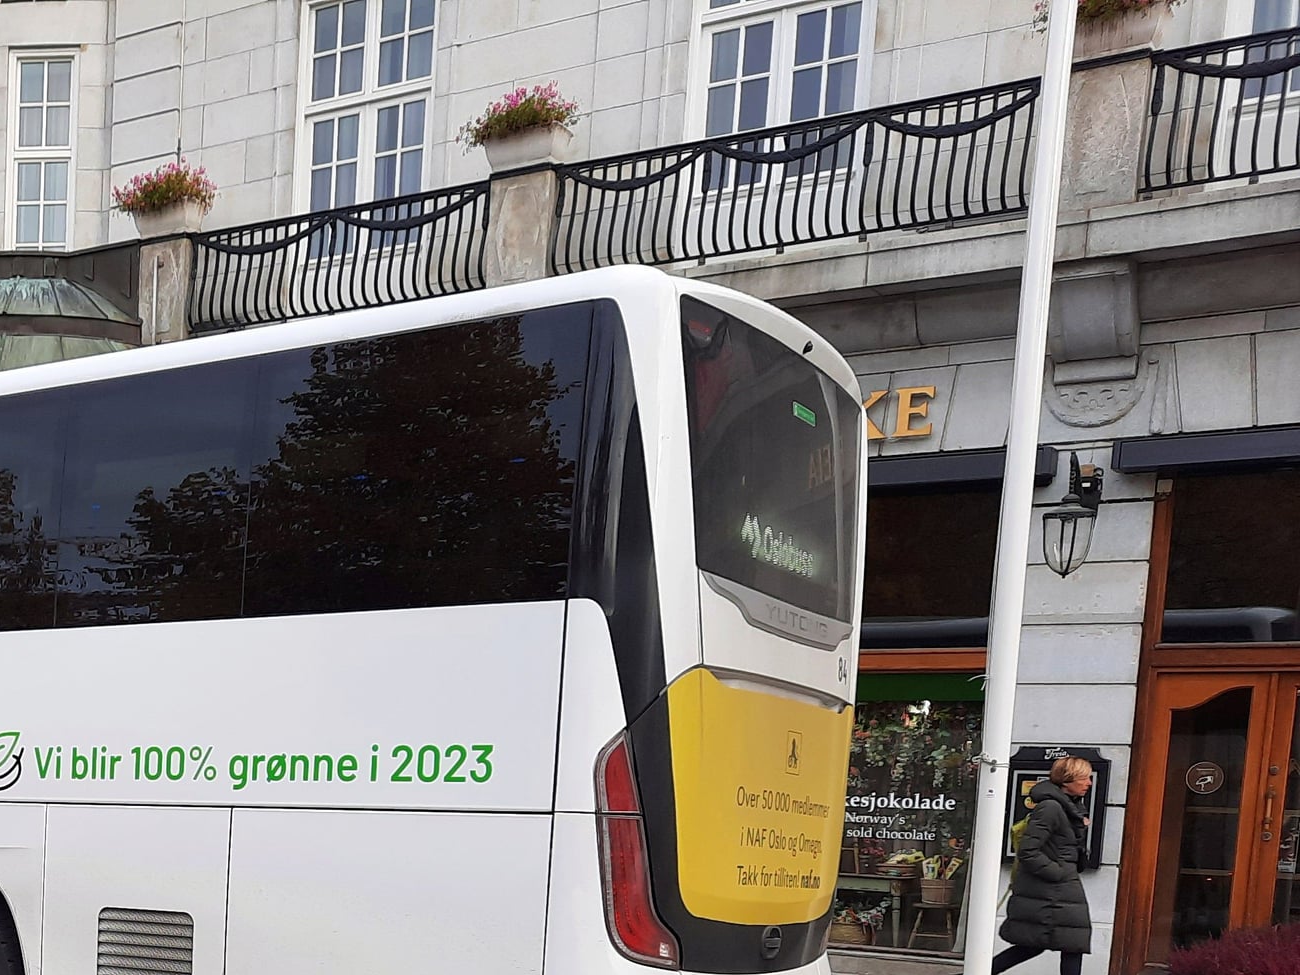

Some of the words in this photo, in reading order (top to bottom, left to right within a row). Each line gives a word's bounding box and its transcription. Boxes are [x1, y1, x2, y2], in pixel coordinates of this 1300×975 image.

[837, 656, 848, 686] 84
[34, 746, 62, 780] Vi
[71, 747, 122, 780] blir
[130, 746, 217, 781] 100%
[229, 751, 358, 790] grønne
[369, 744, 379, 782] i
[390, 744, 494, 783] 2023
[737, 786, 760, 808] Over
[762, 790, 774, 810] 50
[775, 791, 790, 813] 000
[792, 795, 830, 818] medlemmer
[746, 828, 767, 848] NAF
[768, 829, 786, 850] Oslo
[788, 837, 798, 857] og
[846, 827, 873, 838] sold
[875, 829, 936, 840] chocolate
[737, 865, 758, 887] Takk
[760, 866, 772, 887] for
[801, 869, 821, 890] naf.no
